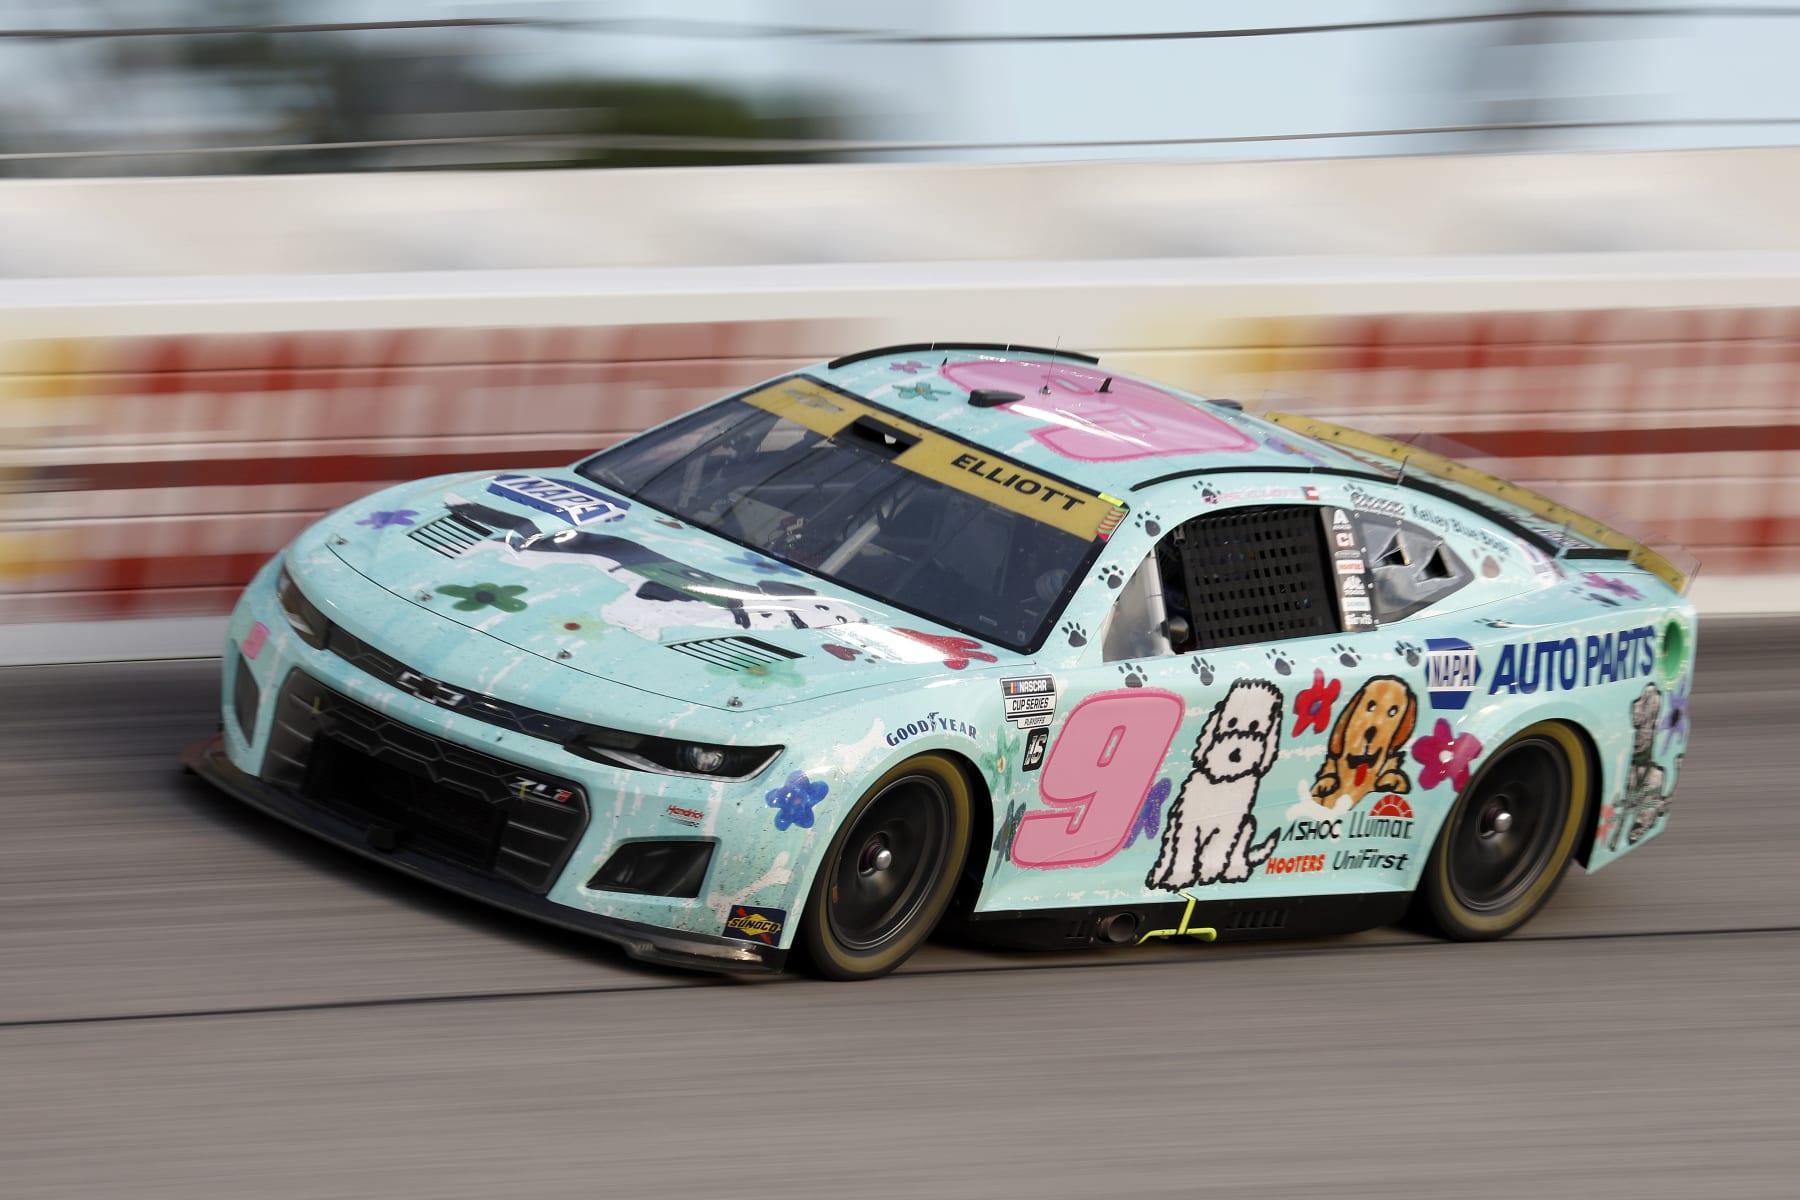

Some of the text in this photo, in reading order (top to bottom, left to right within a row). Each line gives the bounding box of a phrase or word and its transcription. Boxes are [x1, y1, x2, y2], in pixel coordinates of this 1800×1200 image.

[950, 453, 1086, 511] ELLIOTT
[503, 477, 614, 522] NAPA
[1429, 655, 1475, 688] NAPA
[1488, 625, 1656, 696] AUTO PARTS
[1019, 680, 1047, 693] NASCAR
[1012, 698, 1049, 711] CUP SERIES
[1011, 687, 1186, 871] 9
[1265, 854, 1326, 874] HOOTERS
[1333, 849, 1409, 870] UniFirst
[730, 918, 779, 932] SUNOCO
